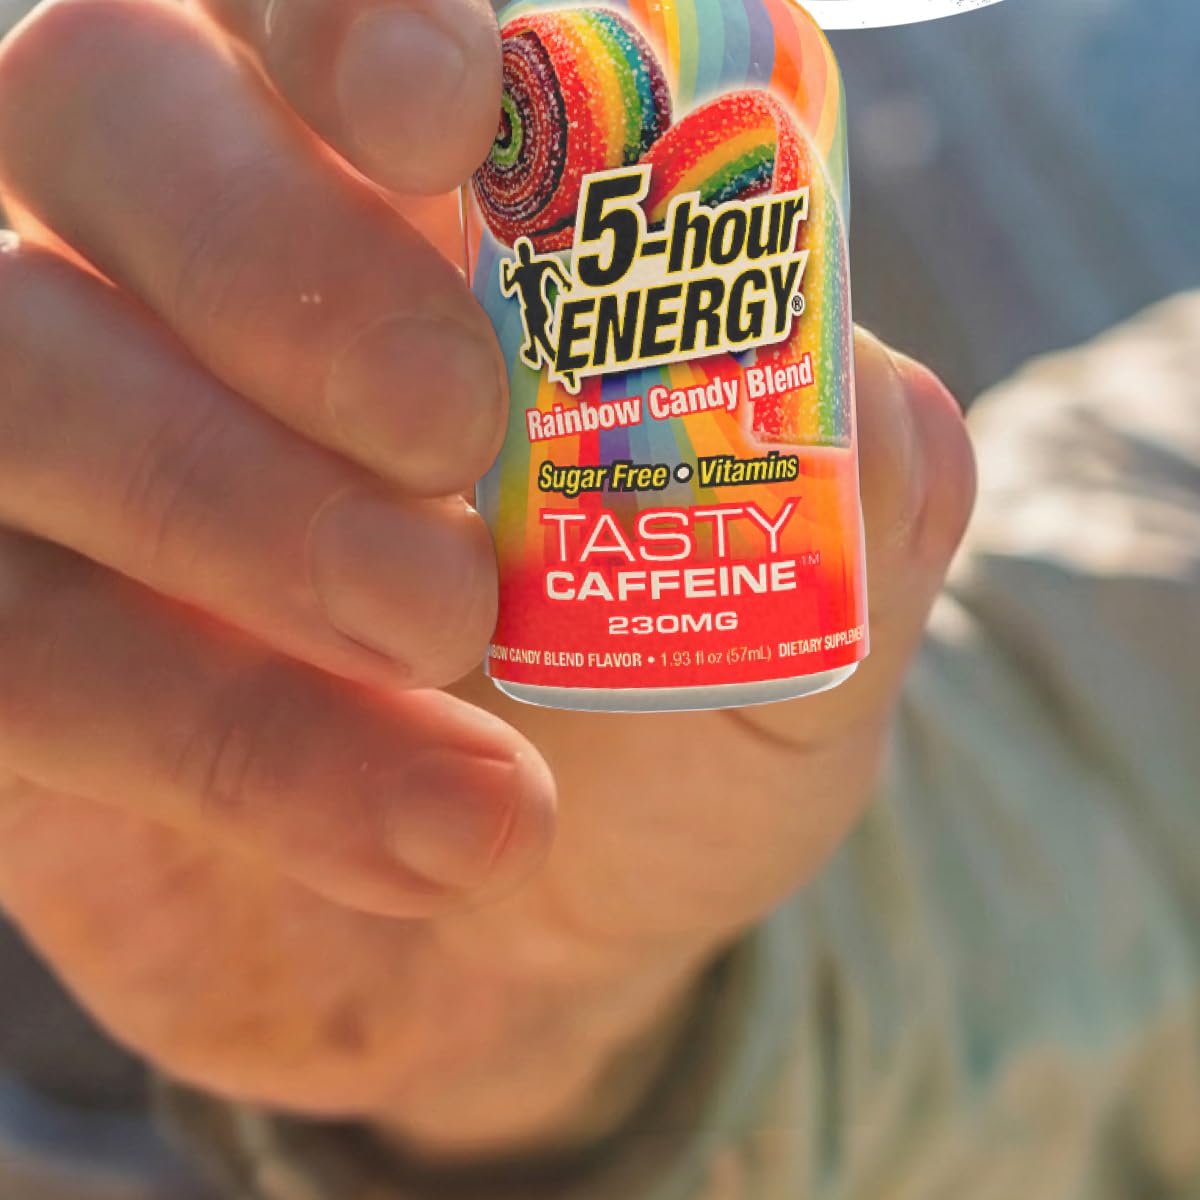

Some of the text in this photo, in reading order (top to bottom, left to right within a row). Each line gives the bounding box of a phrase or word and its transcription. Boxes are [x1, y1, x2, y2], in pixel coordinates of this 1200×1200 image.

[575, 171, 804, 288] 5-hour
[527, 356, 813, 440] Rainbow Candy Blend
[539, 454, 798, 495] Sugar Free Vitamins
[541, 503, 795, 563] TASTY
[545, 559, 797, 602] CAFFEINE
[607, 611, 740, 635] 230MG
[509, 647, 542, 665] CANDY
[543, 650, 585, 667] BLEND
[588, 652, 642, 668] FLAVOR
[660, 650, 691, 667] 1.93
[696, 650, 704, 665] fl
[707, 651, 723, 665] oz
[726, 646, 772, 665] (57mL)
[779, 637, 823, 658] DIETARY
